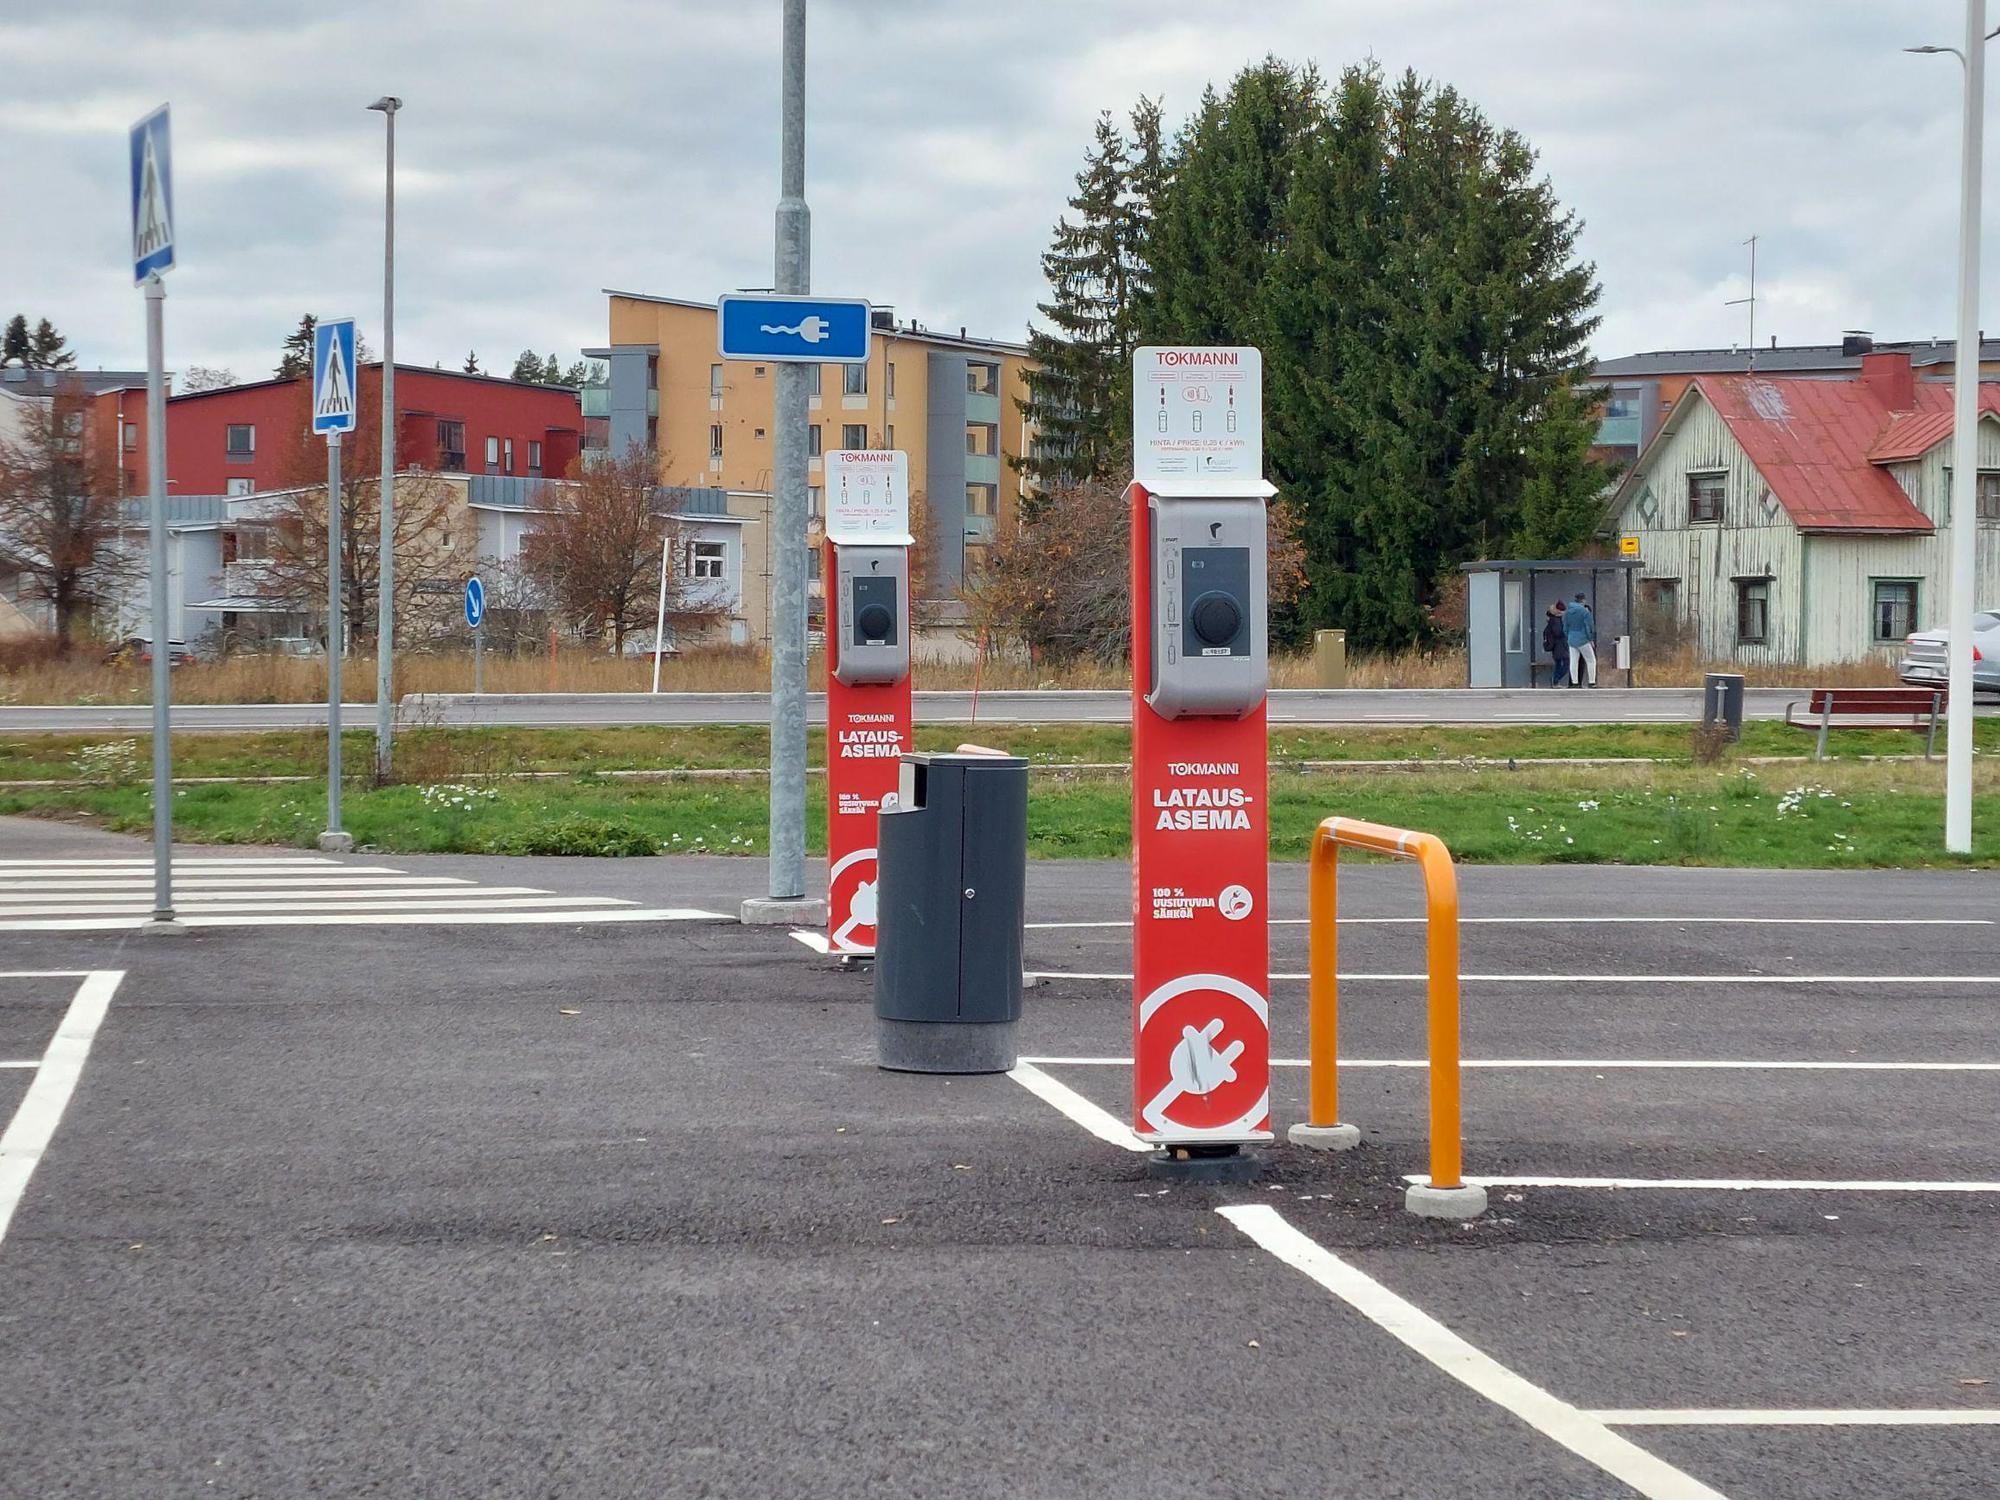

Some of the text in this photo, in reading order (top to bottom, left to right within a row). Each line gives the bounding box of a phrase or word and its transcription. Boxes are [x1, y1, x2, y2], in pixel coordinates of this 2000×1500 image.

[1156, 352, 1238, 366] TOKMANNI
[840, 453, 893, 462] TOKMANNI
[848, 714, 894, 723] TOKMANNI
[838, 730, 904, 743] LATAUS-
[840, 744, 901, 758] ASEMA
[1167, 762, 1239, 775] TOKMANNI
[1153, 788, 1253, 807] LATAUS-
[1155, 809, 1251, 830] ASEMA
[1152, 887, 1185, 897] 100 %
[1152, 898, 1216, 908] UUSIUTUVAA
[1152, 907, 1194, 919] SÄHKÖÄ
